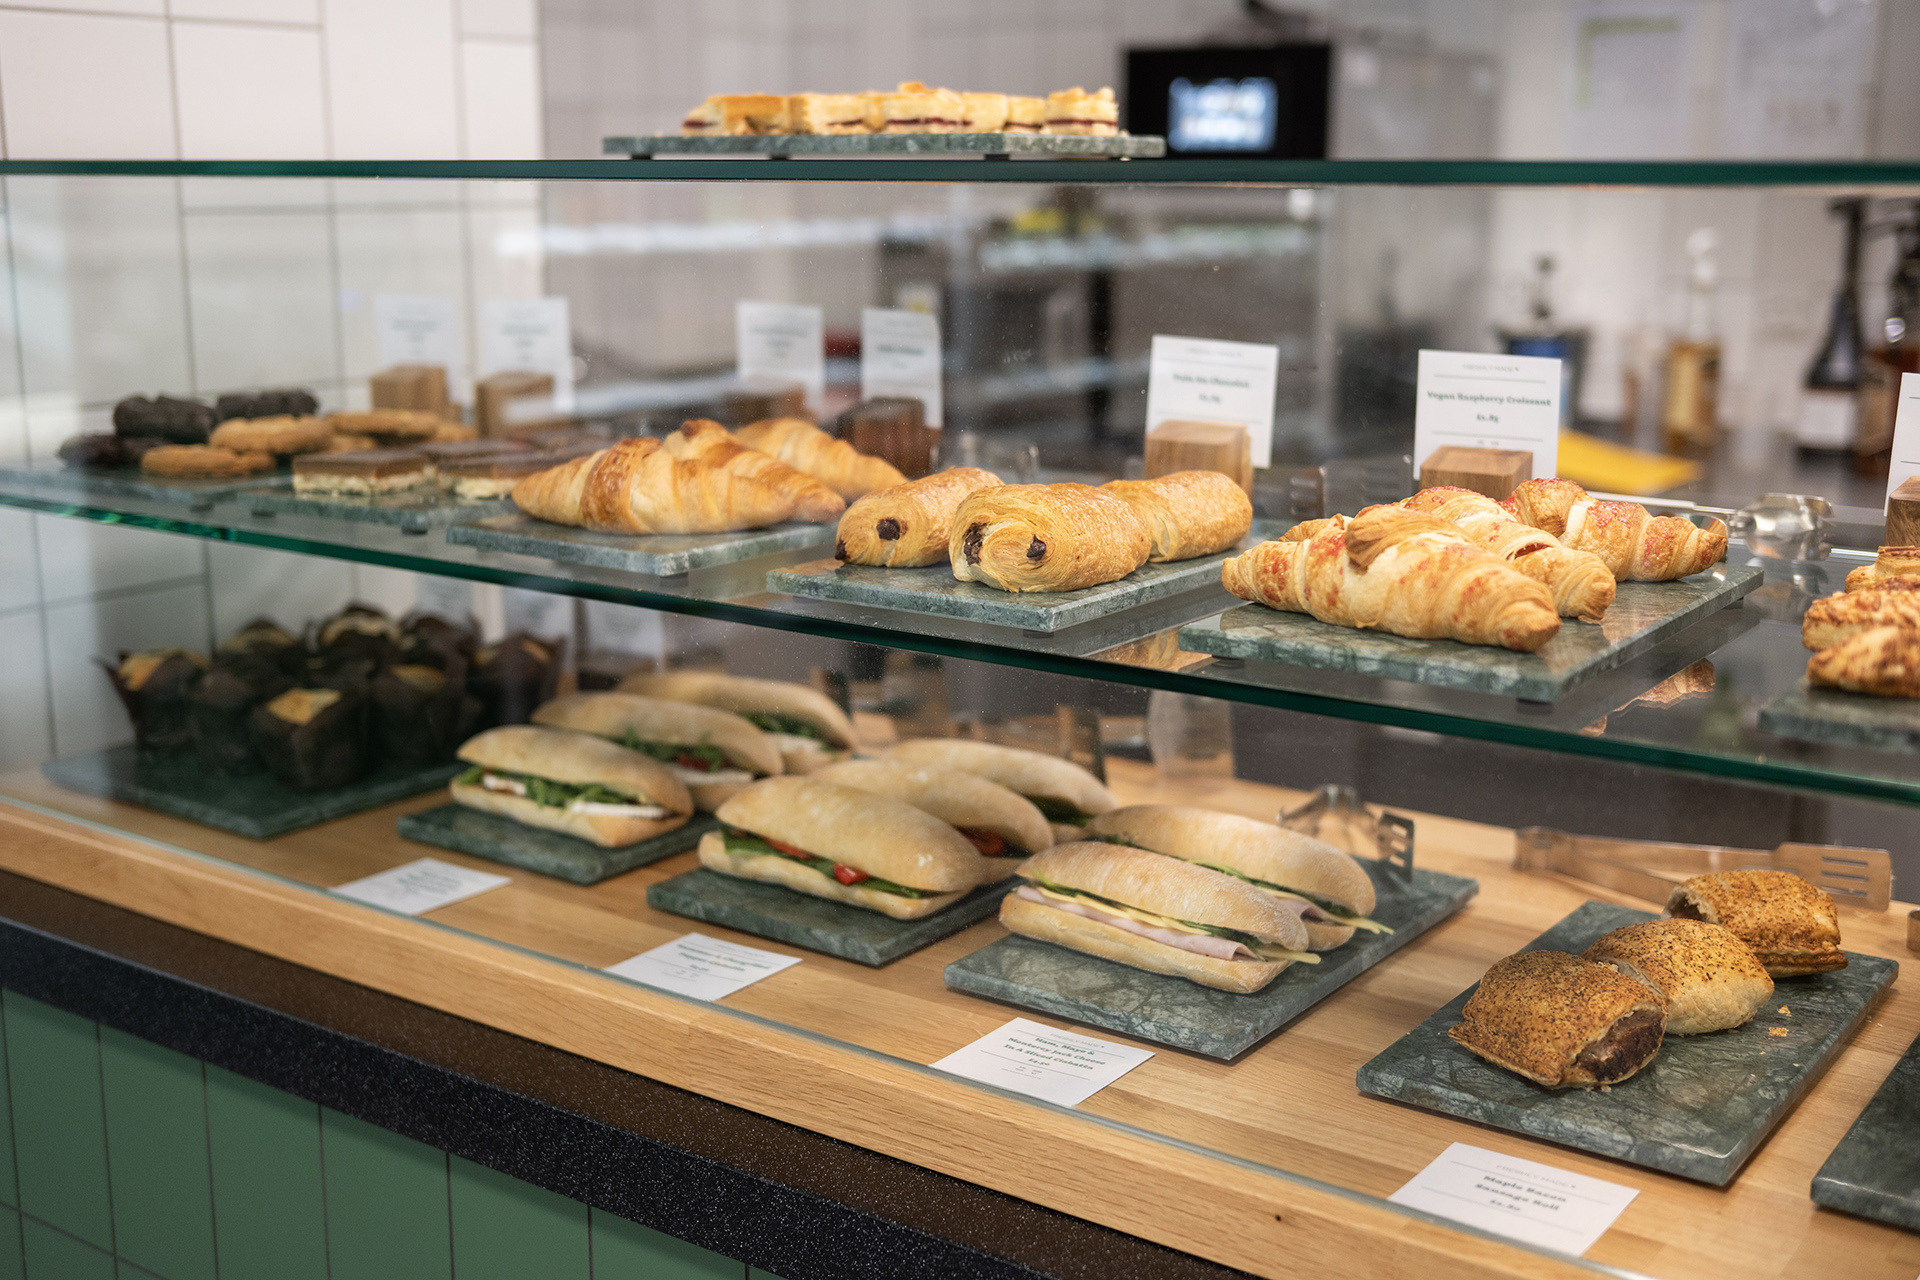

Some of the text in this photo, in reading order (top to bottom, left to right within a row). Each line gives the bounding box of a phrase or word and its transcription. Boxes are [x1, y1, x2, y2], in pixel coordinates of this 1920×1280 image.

[1427, 391, 1551, 407] Vegan Raspberry Croissant
[1008, 1037, 1106, 1066] Monterey Jack Cheese
[1034, 1037, 1059, 1048] Ham,
[1060, 1044, 1087, 1054] Mayo
[1053, 1057, 1094, 1070] Ciabatta
[1475, 1183, 1560, 1211] Sausage Roll
[1483, 1175, 1567, 1202] Maple Bacon
